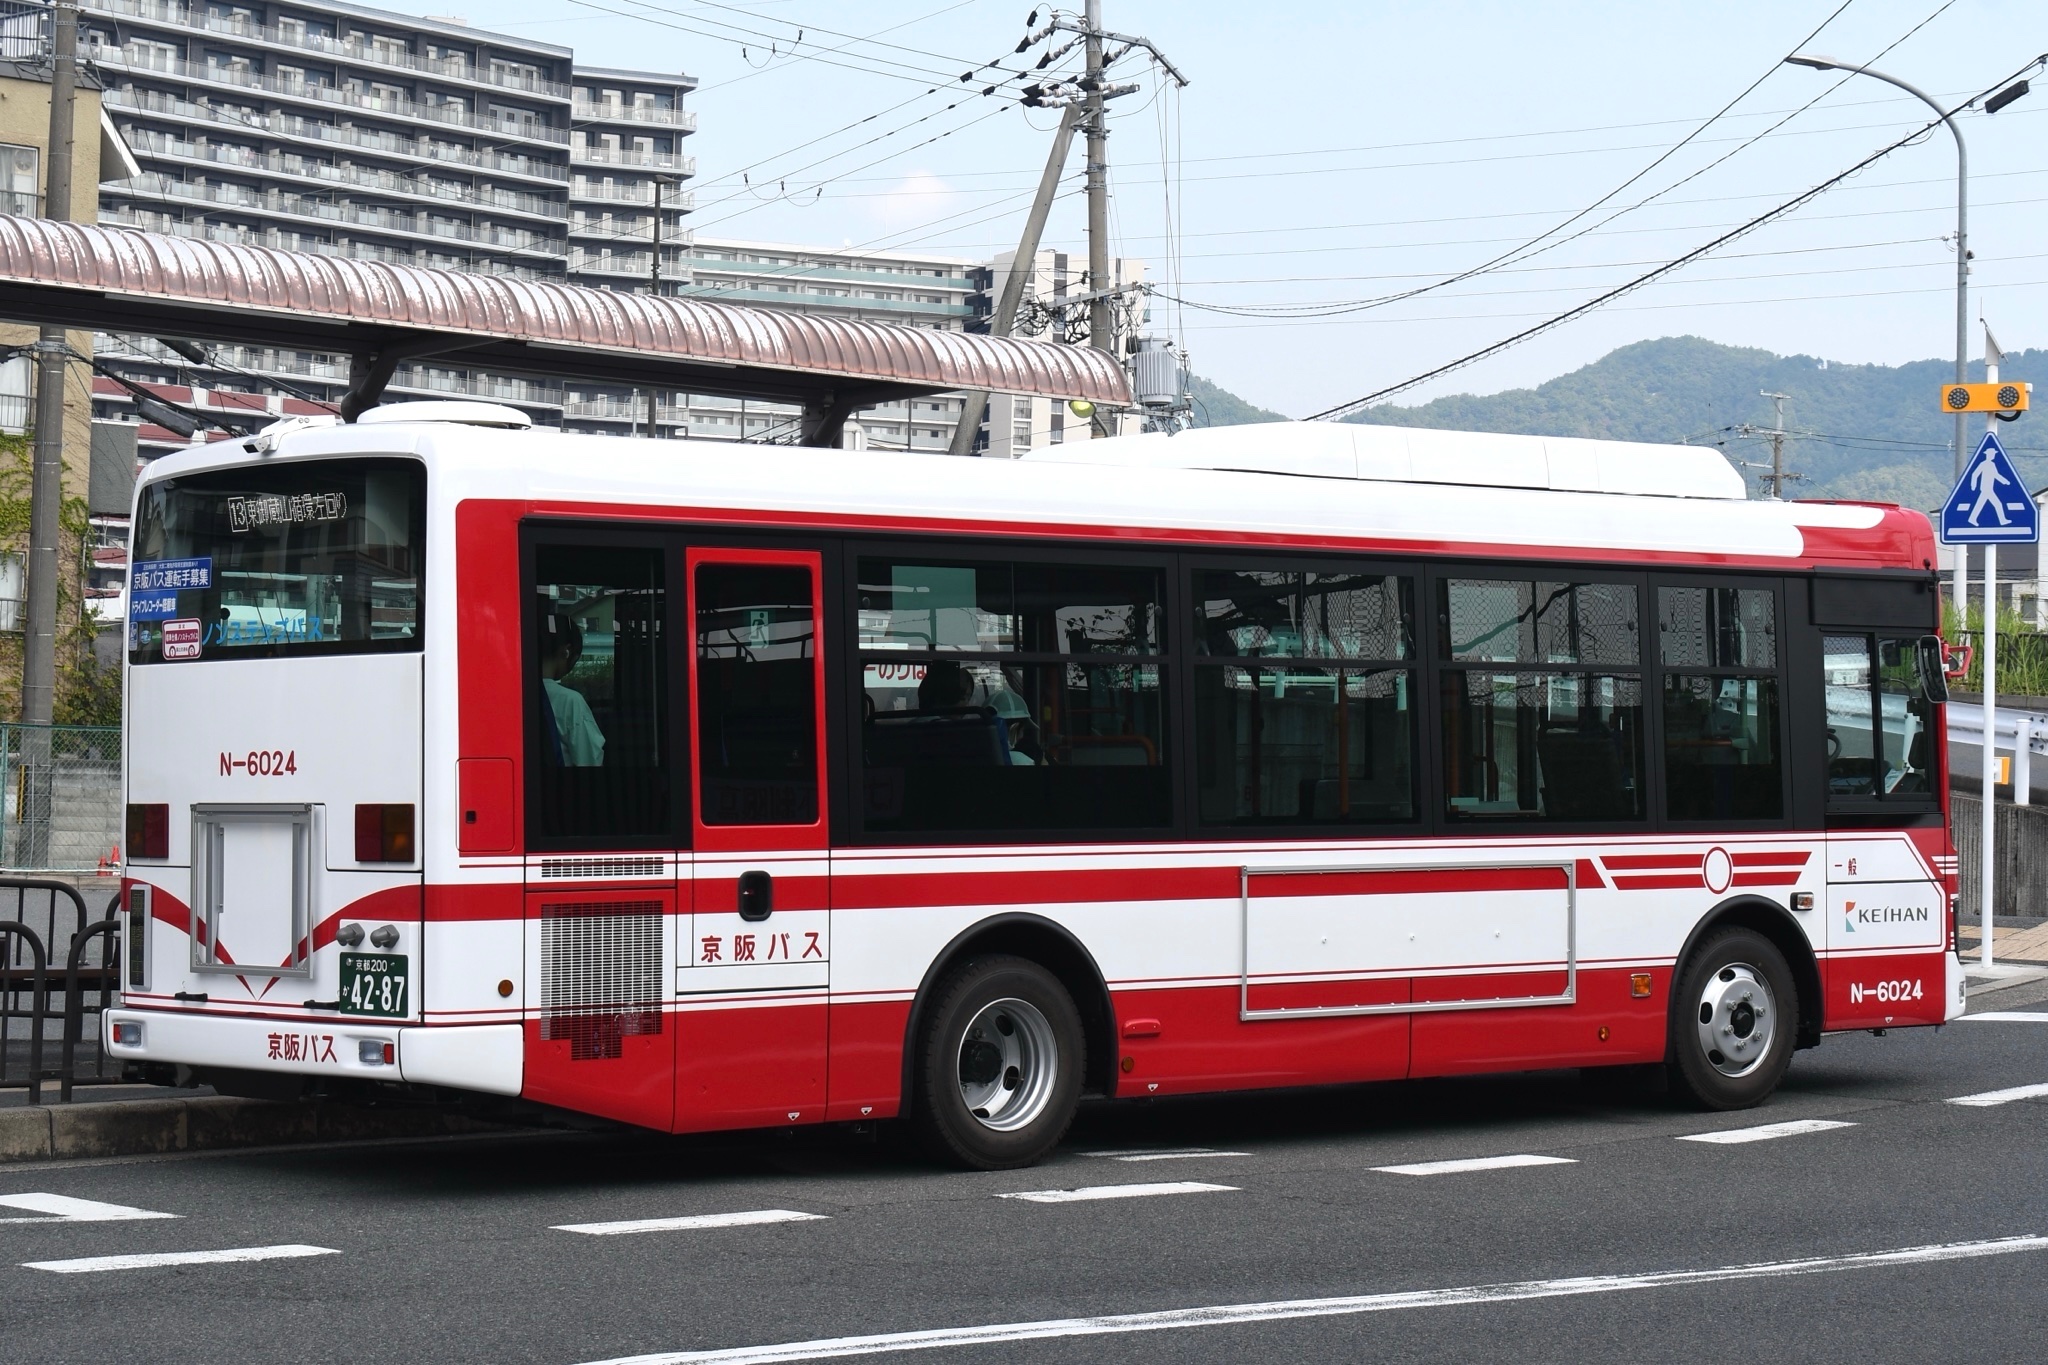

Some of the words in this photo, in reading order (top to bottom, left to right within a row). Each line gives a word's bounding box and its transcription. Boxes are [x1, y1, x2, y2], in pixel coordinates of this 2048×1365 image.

[231, 501, 245, 526] 13
[133, 568, 209, 589] 京阪バス運転手募集
[202, 616, 323, 646] ノンステップバス
[220, 750, 297, 777] N-6024
[1834, 858, 1857, 876] 一般
[1858, 906, 1928, 923] KEIHAN
[701, 932, 822, 963] 京阪バス
[351, 973, 405, 1012] 42-87
[1850, 979, 1924, 1004] N-6024
[268, 1032, 337, 1063] 京阪バス
